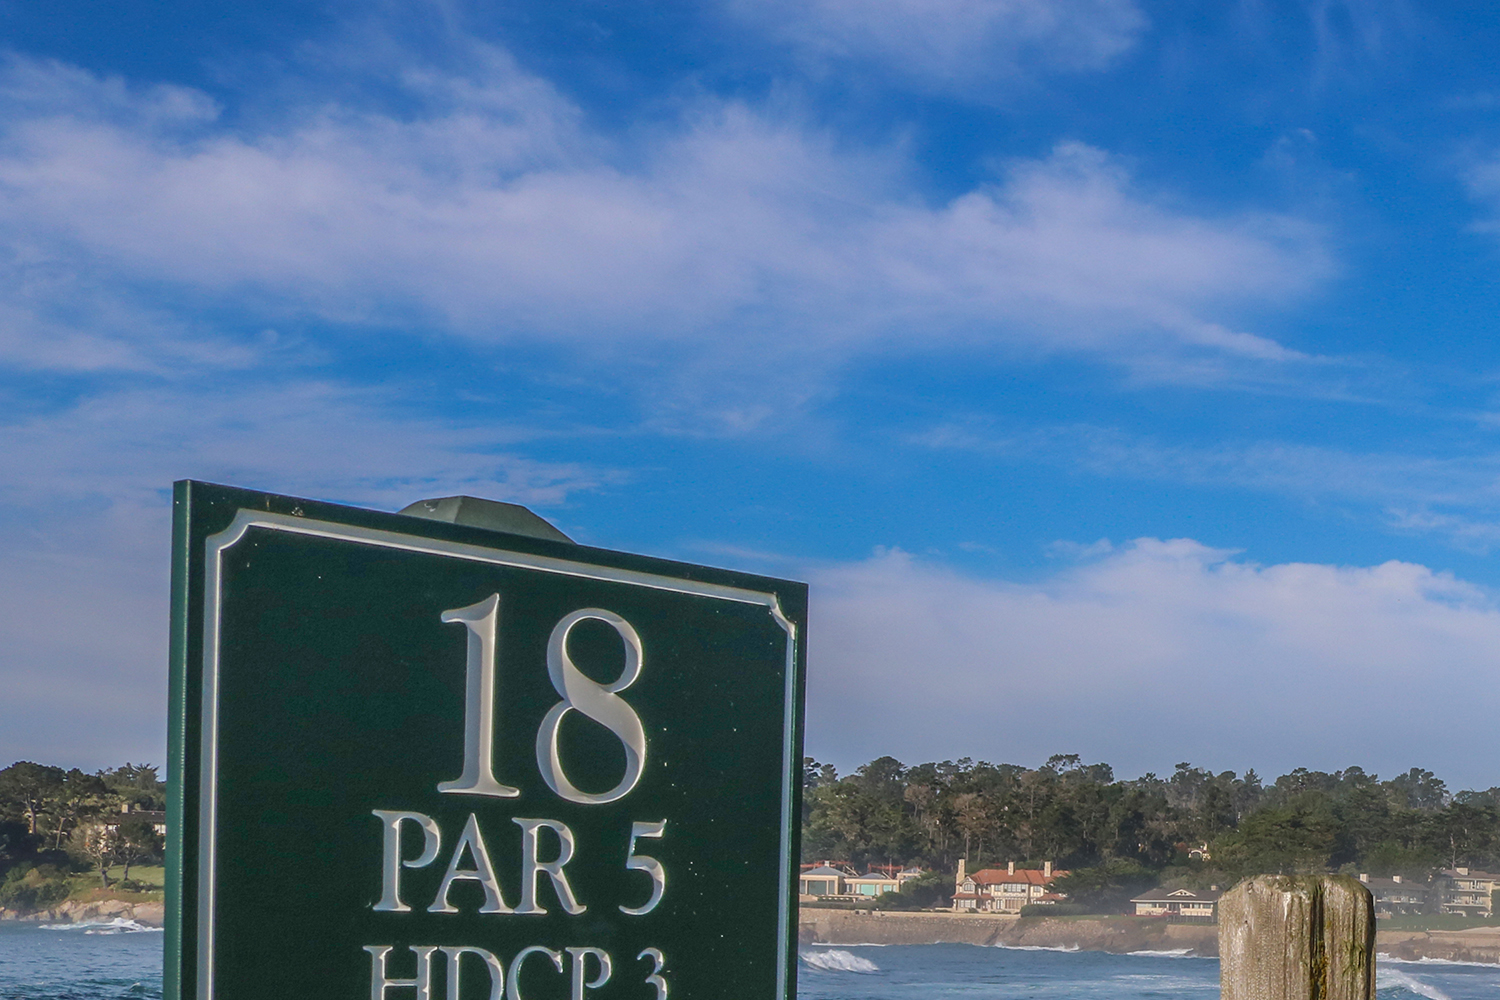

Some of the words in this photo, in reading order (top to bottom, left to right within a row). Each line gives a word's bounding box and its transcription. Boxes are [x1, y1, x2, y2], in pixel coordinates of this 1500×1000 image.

[437, 592, 646, 804] 18
[372, 809, 587, 915] PAR
[619, 818, 667, 916] 5
